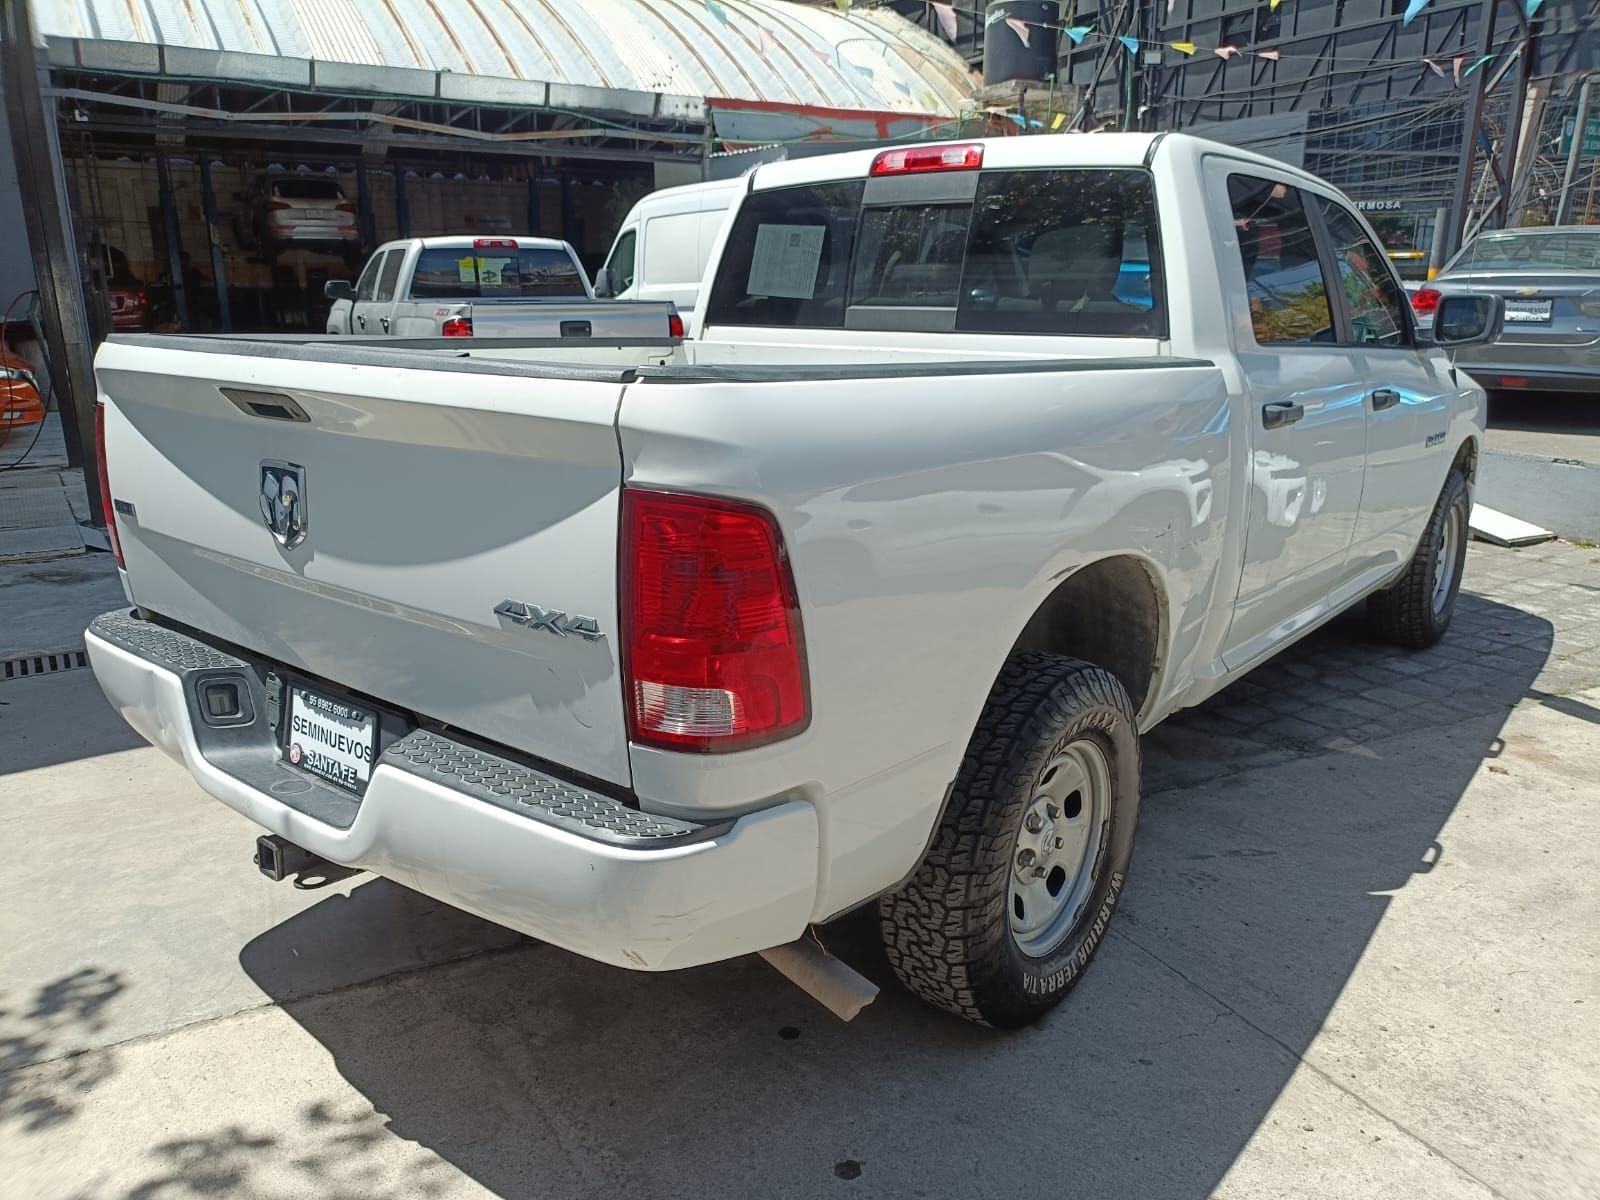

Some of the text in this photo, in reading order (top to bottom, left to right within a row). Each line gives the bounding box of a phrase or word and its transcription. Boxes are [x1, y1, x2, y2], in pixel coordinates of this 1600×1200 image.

[292, 714, 372, 764] SEMINUEVOS
[307, 750, 340, 778] SANTA
[341, 764, 356, 784] FE
[1077, 871, 1124, 966] WARRIOR
[1039, 959, 1078, 995] TERRA
